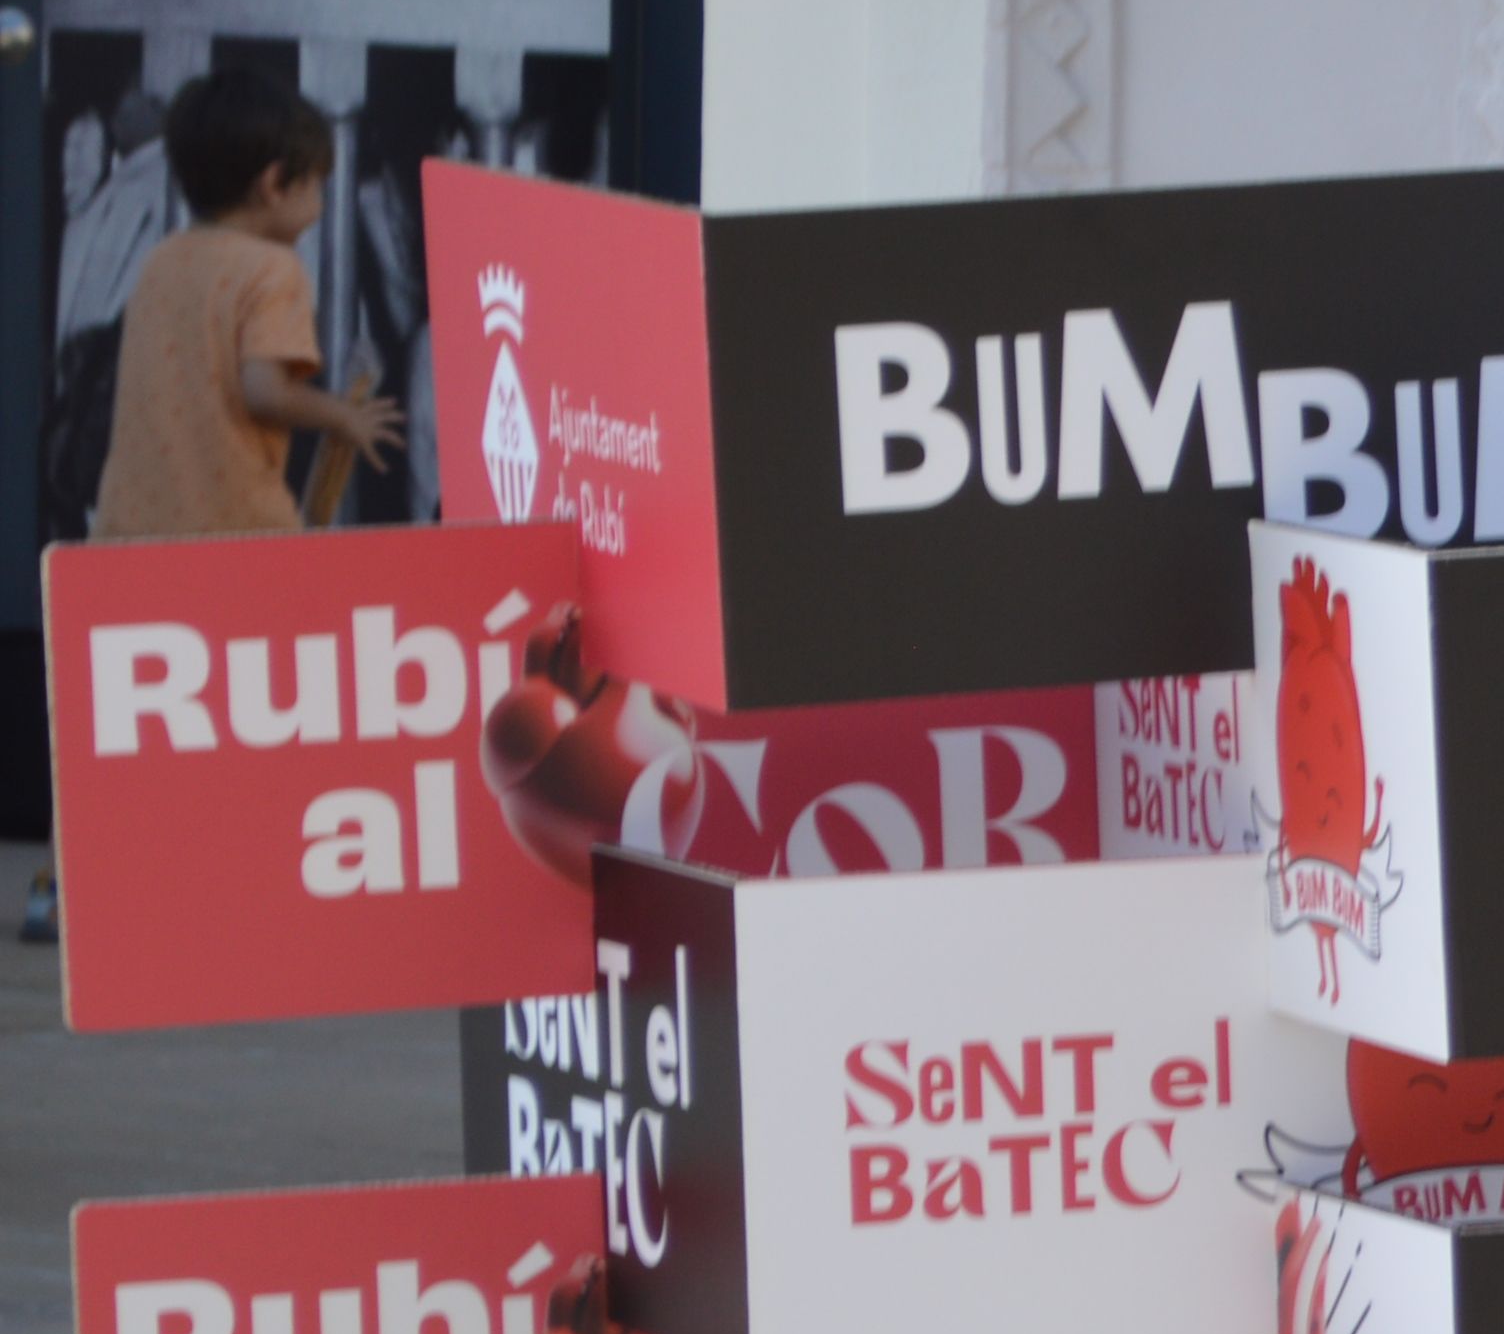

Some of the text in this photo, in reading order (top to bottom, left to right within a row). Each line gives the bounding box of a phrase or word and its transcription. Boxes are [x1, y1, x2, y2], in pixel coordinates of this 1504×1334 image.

[549, 382, 662, 475] Ajuntament
[580, 479, 625, 557] Rubí
[90, 587, 531, 758] Rubí
[301, 760, 460, 899] al
[1150, 1018, 1231, 1109] el
